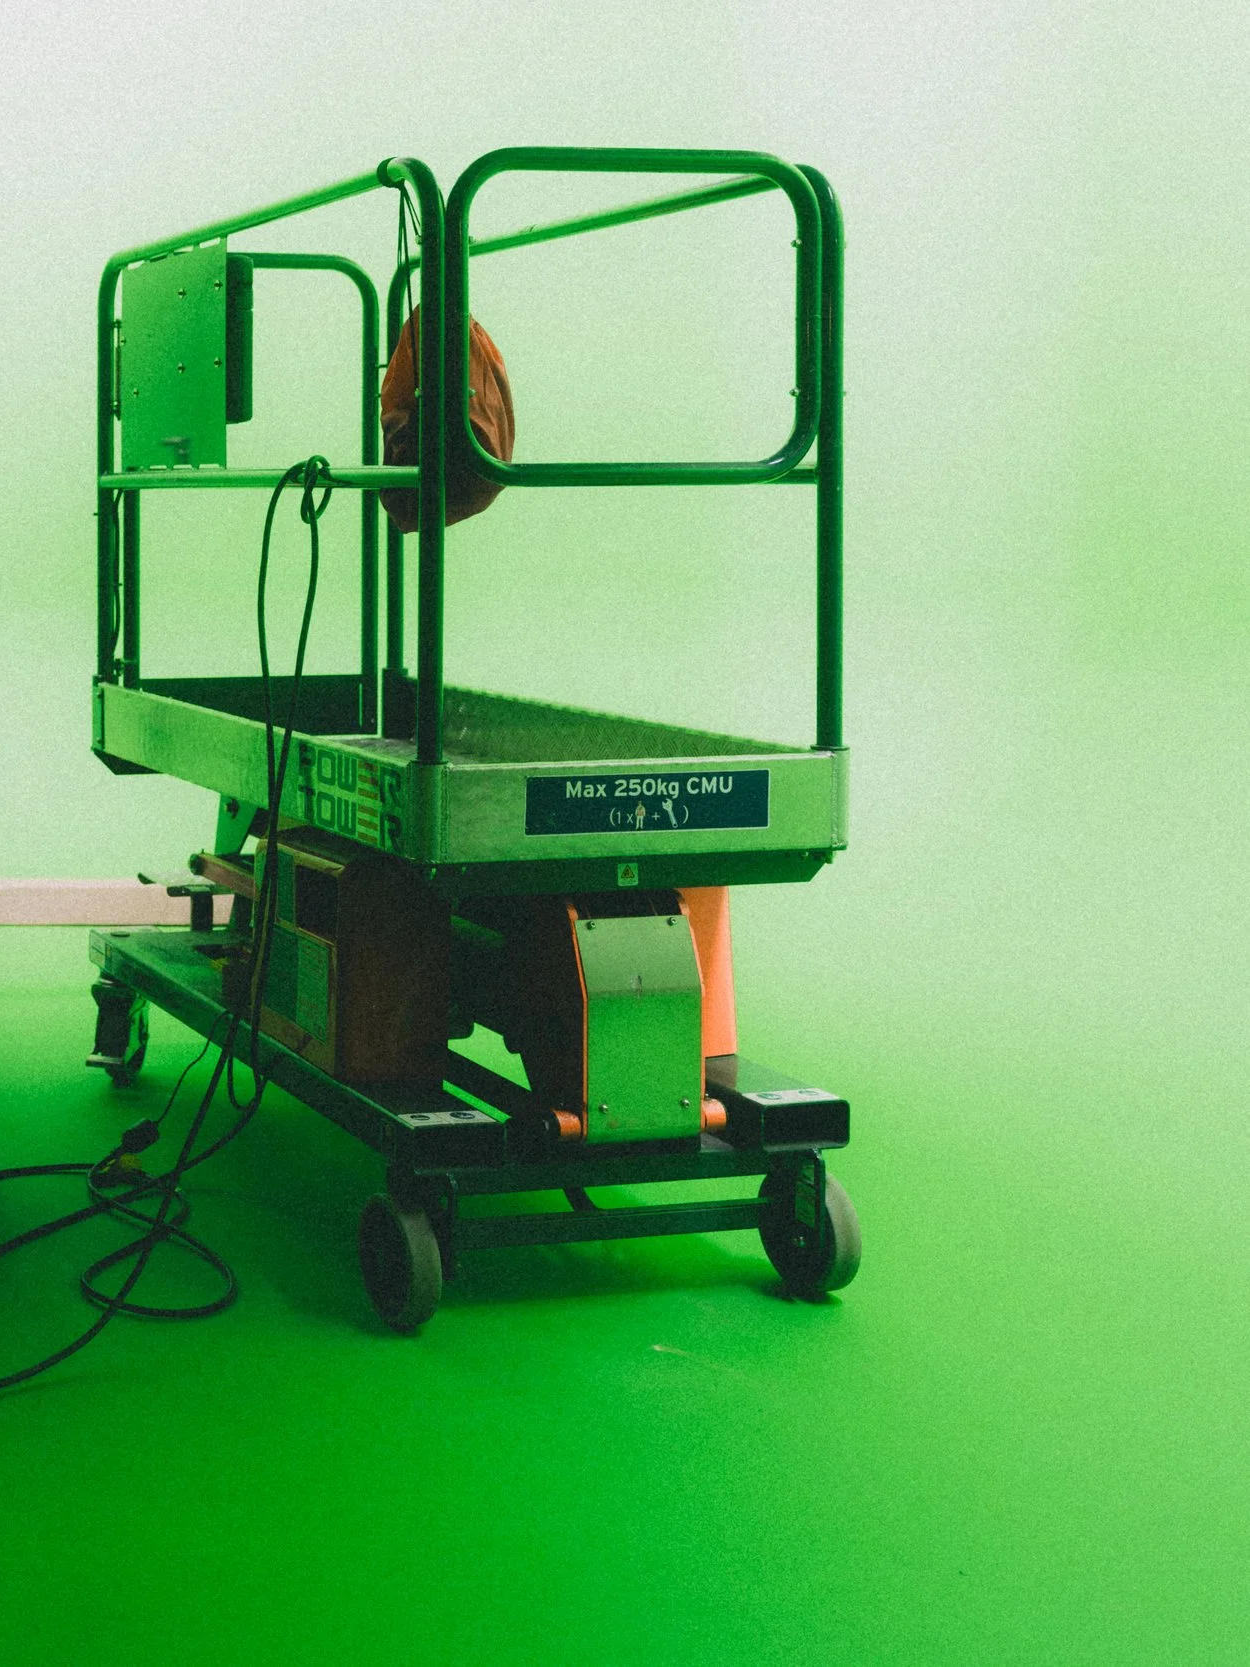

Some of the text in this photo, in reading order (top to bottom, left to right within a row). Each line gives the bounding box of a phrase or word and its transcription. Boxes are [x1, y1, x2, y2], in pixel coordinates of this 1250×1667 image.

[298, 742, 402, 807] POWER
[565, 776, 733, 798] Max 250kg CMU
[297, 784, 402, 851] TOWER
